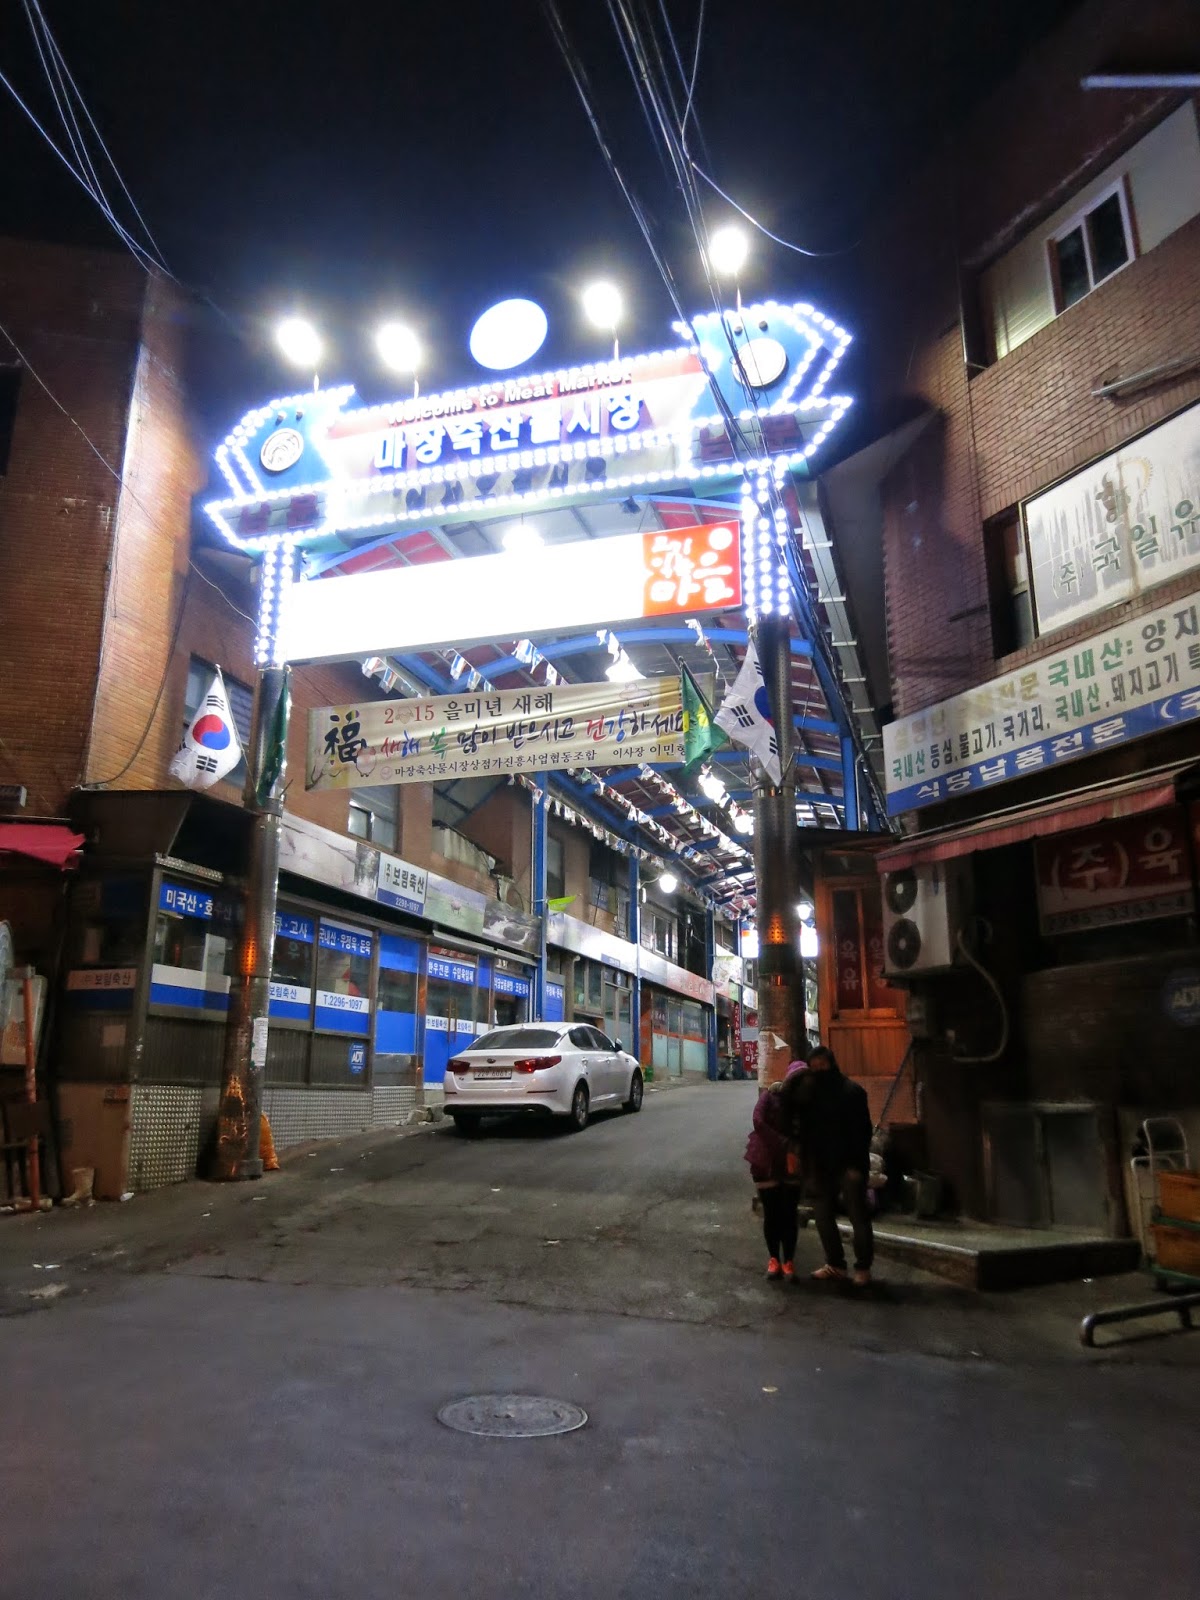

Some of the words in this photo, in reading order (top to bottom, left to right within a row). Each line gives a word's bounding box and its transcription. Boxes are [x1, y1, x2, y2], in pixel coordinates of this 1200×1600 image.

[480, 392, 500, 408] to
[504, 382, 554, 403] Meat
[560, 369, 633, 392] Market
[371, 391, 643, 468] 마장축산물시장
[443, 697, 502, 721] 을미년
[513, 692, 553, 715] 새해
[324, 709, 368, 766] 福
[380, 730, 420, 758] 새해
[429, 727, 448, 760] 복
[457, 723, 496, 754] 많이
[506, 717, 575, 749] 받으시고
[612, 746, 645, 768] 이사장
[893, 749, 925, 782] 국내산
[916, 716, 1127, 799] 식당납품전문
[351, 1051, 364, 1063] ADT
